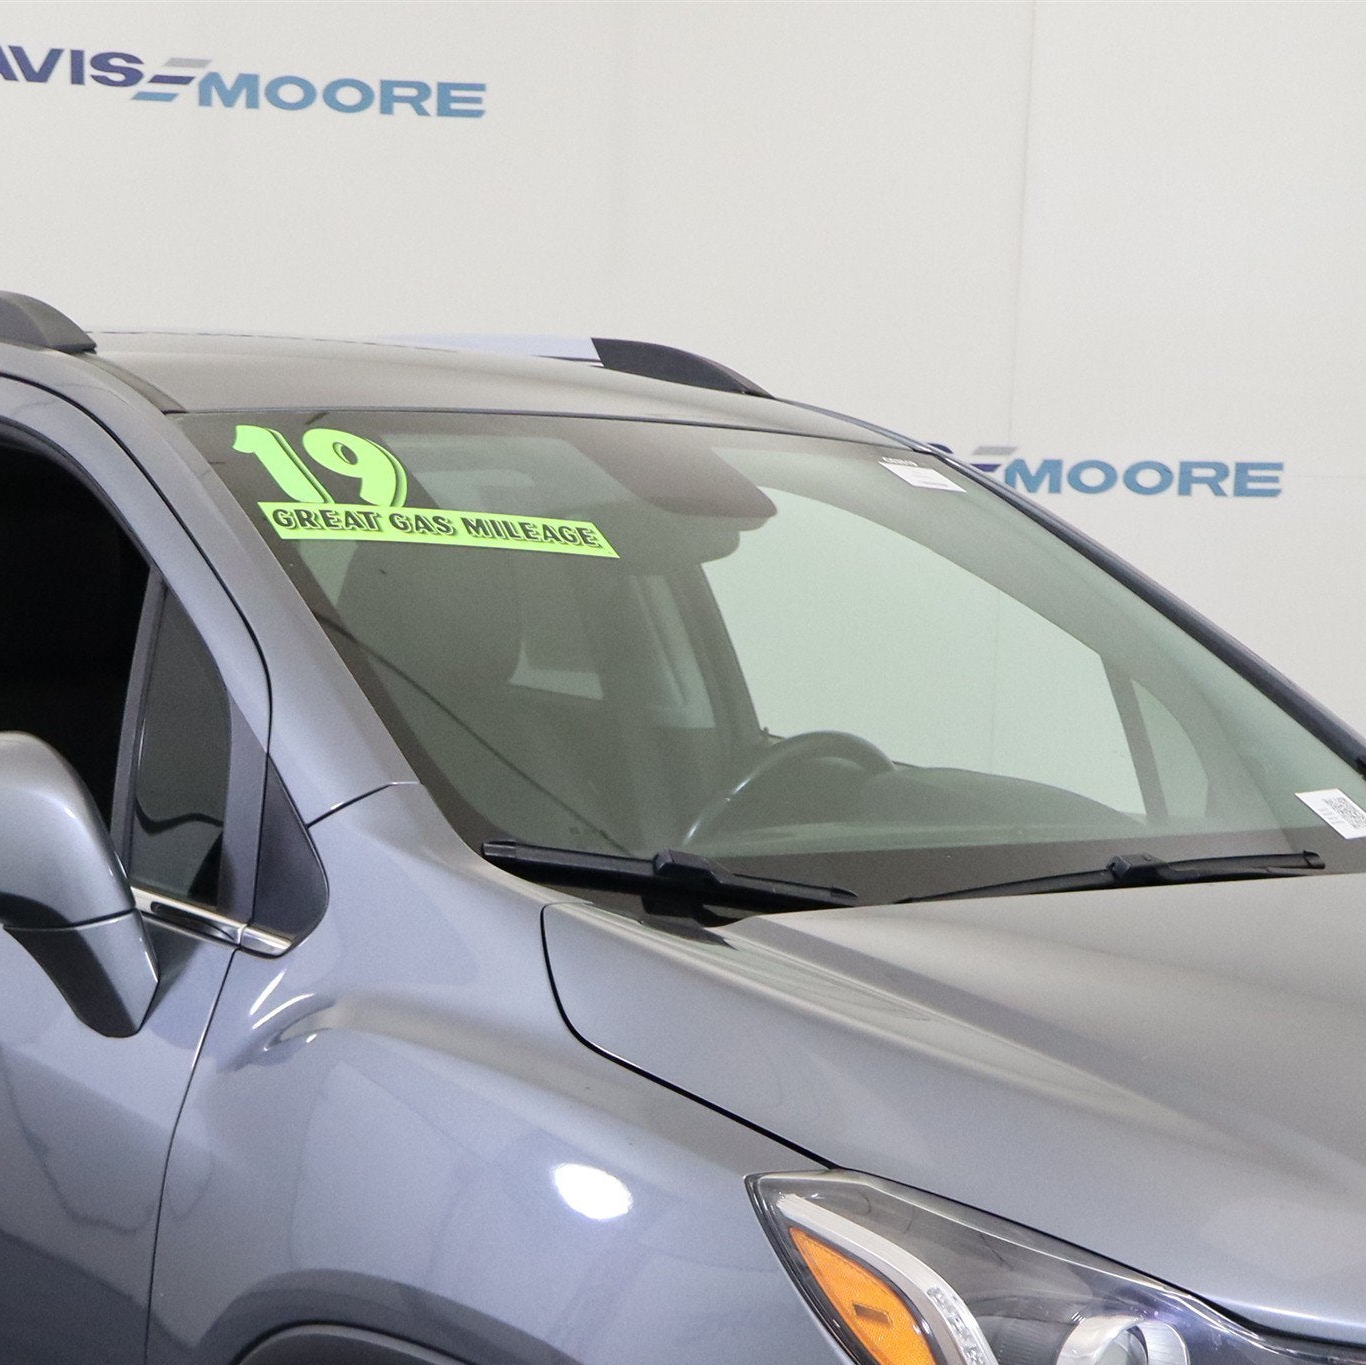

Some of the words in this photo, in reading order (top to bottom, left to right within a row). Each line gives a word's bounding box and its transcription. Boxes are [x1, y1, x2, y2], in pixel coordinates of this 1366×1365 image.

[198, 71, 487, 119] MOORE
[232, 424, 409, 509] 19
[1004, 457, 1284, 498] MOORE
[272, 507, 382, 534] GREAT
[389, 513, 458, 537] GAS
[465, 517, 602, 549] MILEAGE
